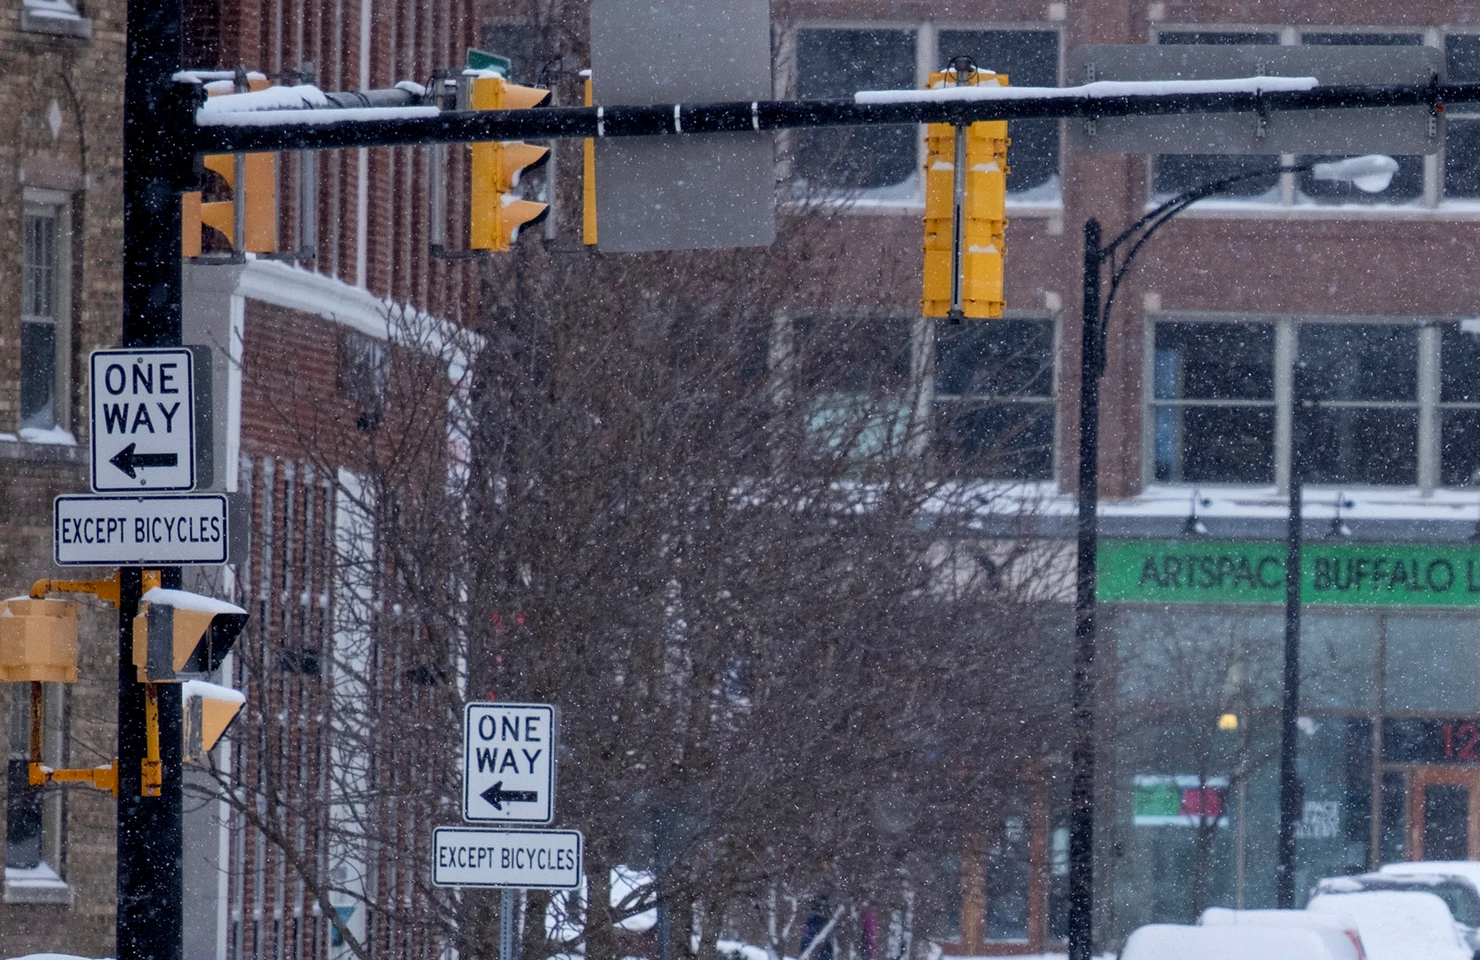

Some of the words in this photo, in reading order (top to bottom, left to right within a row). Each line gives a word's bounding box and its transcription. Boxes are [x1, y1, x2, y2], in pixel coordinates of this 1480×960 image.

[105, 363, 179, 395] ONE
[103, 402, 181, 434] WAY
[62, 517, 127, 543] EXCEPT
[135, 516, 221, 543] BICYCLES
[1139, 556, 1287, 590] ARTSPAC
[1313, 556, 1454, 593] BUFFALO
[478, 715, 541, 742] ONE
[476, 747, 542, 774] WAY
[439, 846, 495, 868] EXCEPT
[501, 847, 574, 870] BICYCLES
